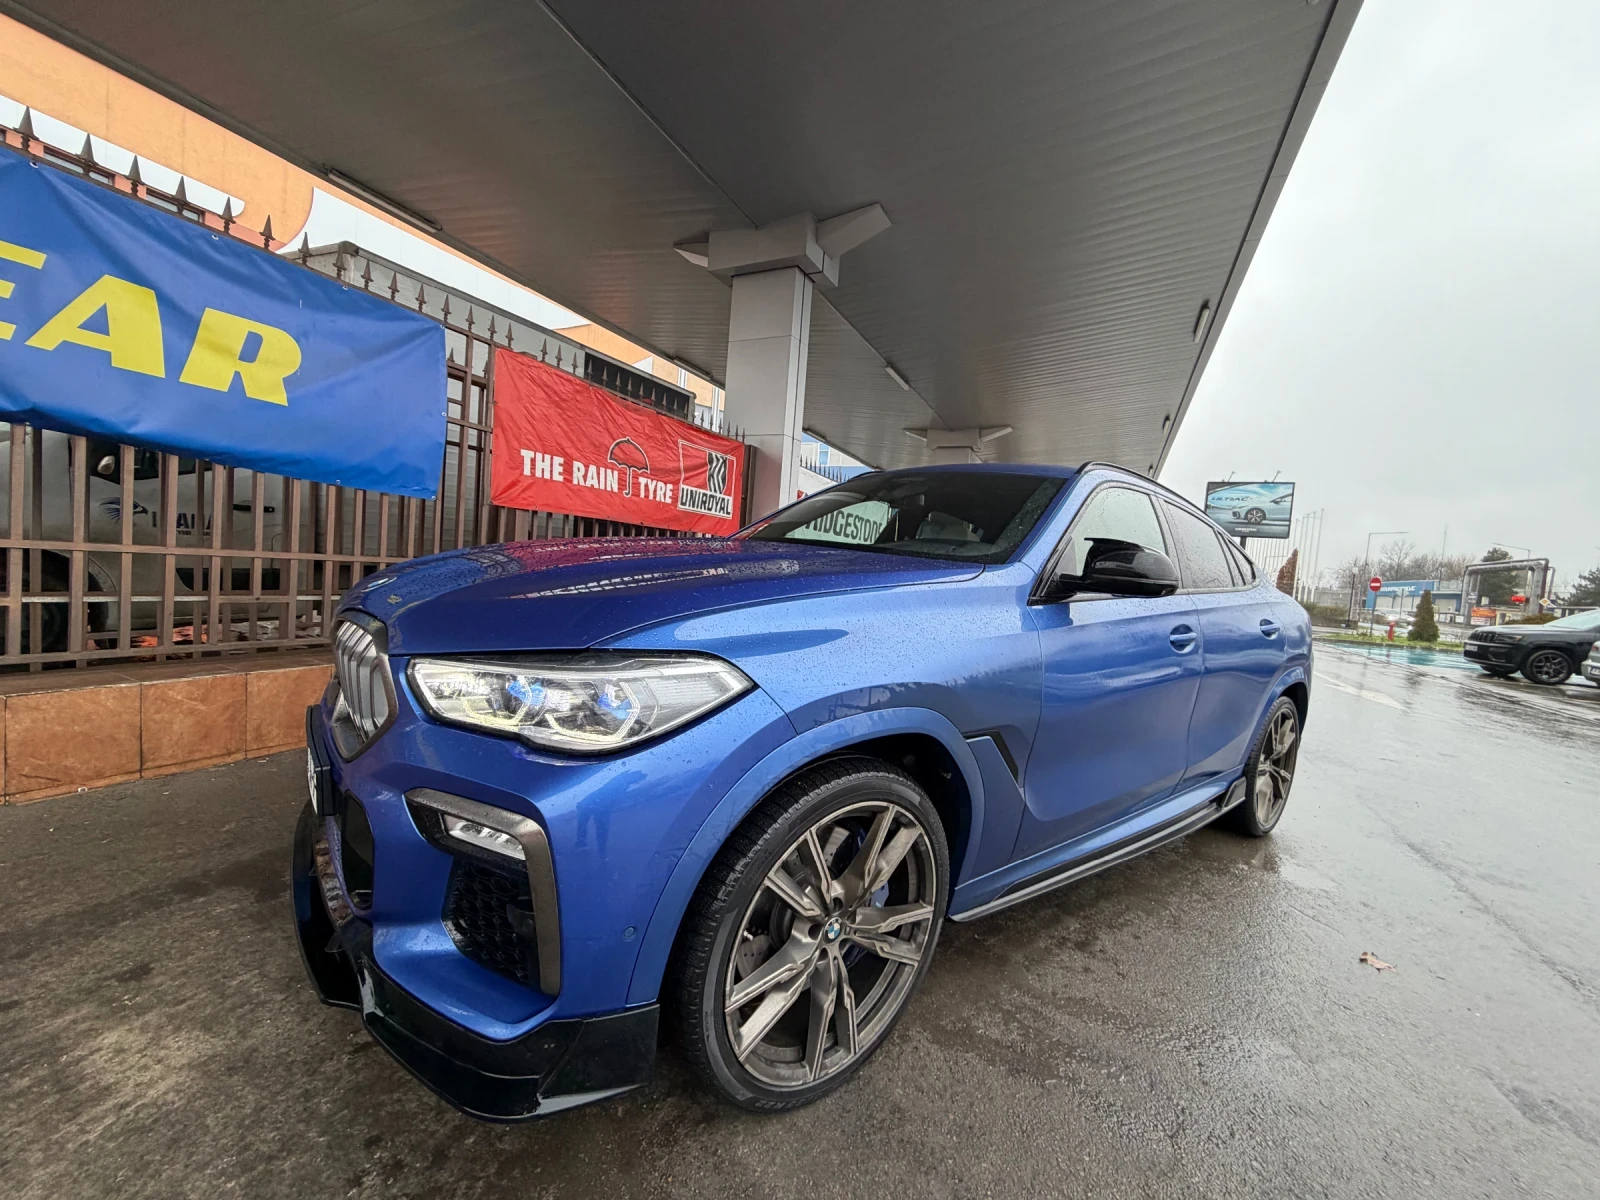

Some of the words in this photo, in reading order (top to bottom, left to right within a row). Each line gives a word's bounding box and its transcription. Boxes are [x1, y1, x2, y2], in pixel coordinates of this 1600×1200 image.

[520, 449, 564, 482] THE
[572, 461, 618, 493] RAIN
[638, 476, 673, 504] TYRE
[680, 487, 732, 516] UNIROYAL
